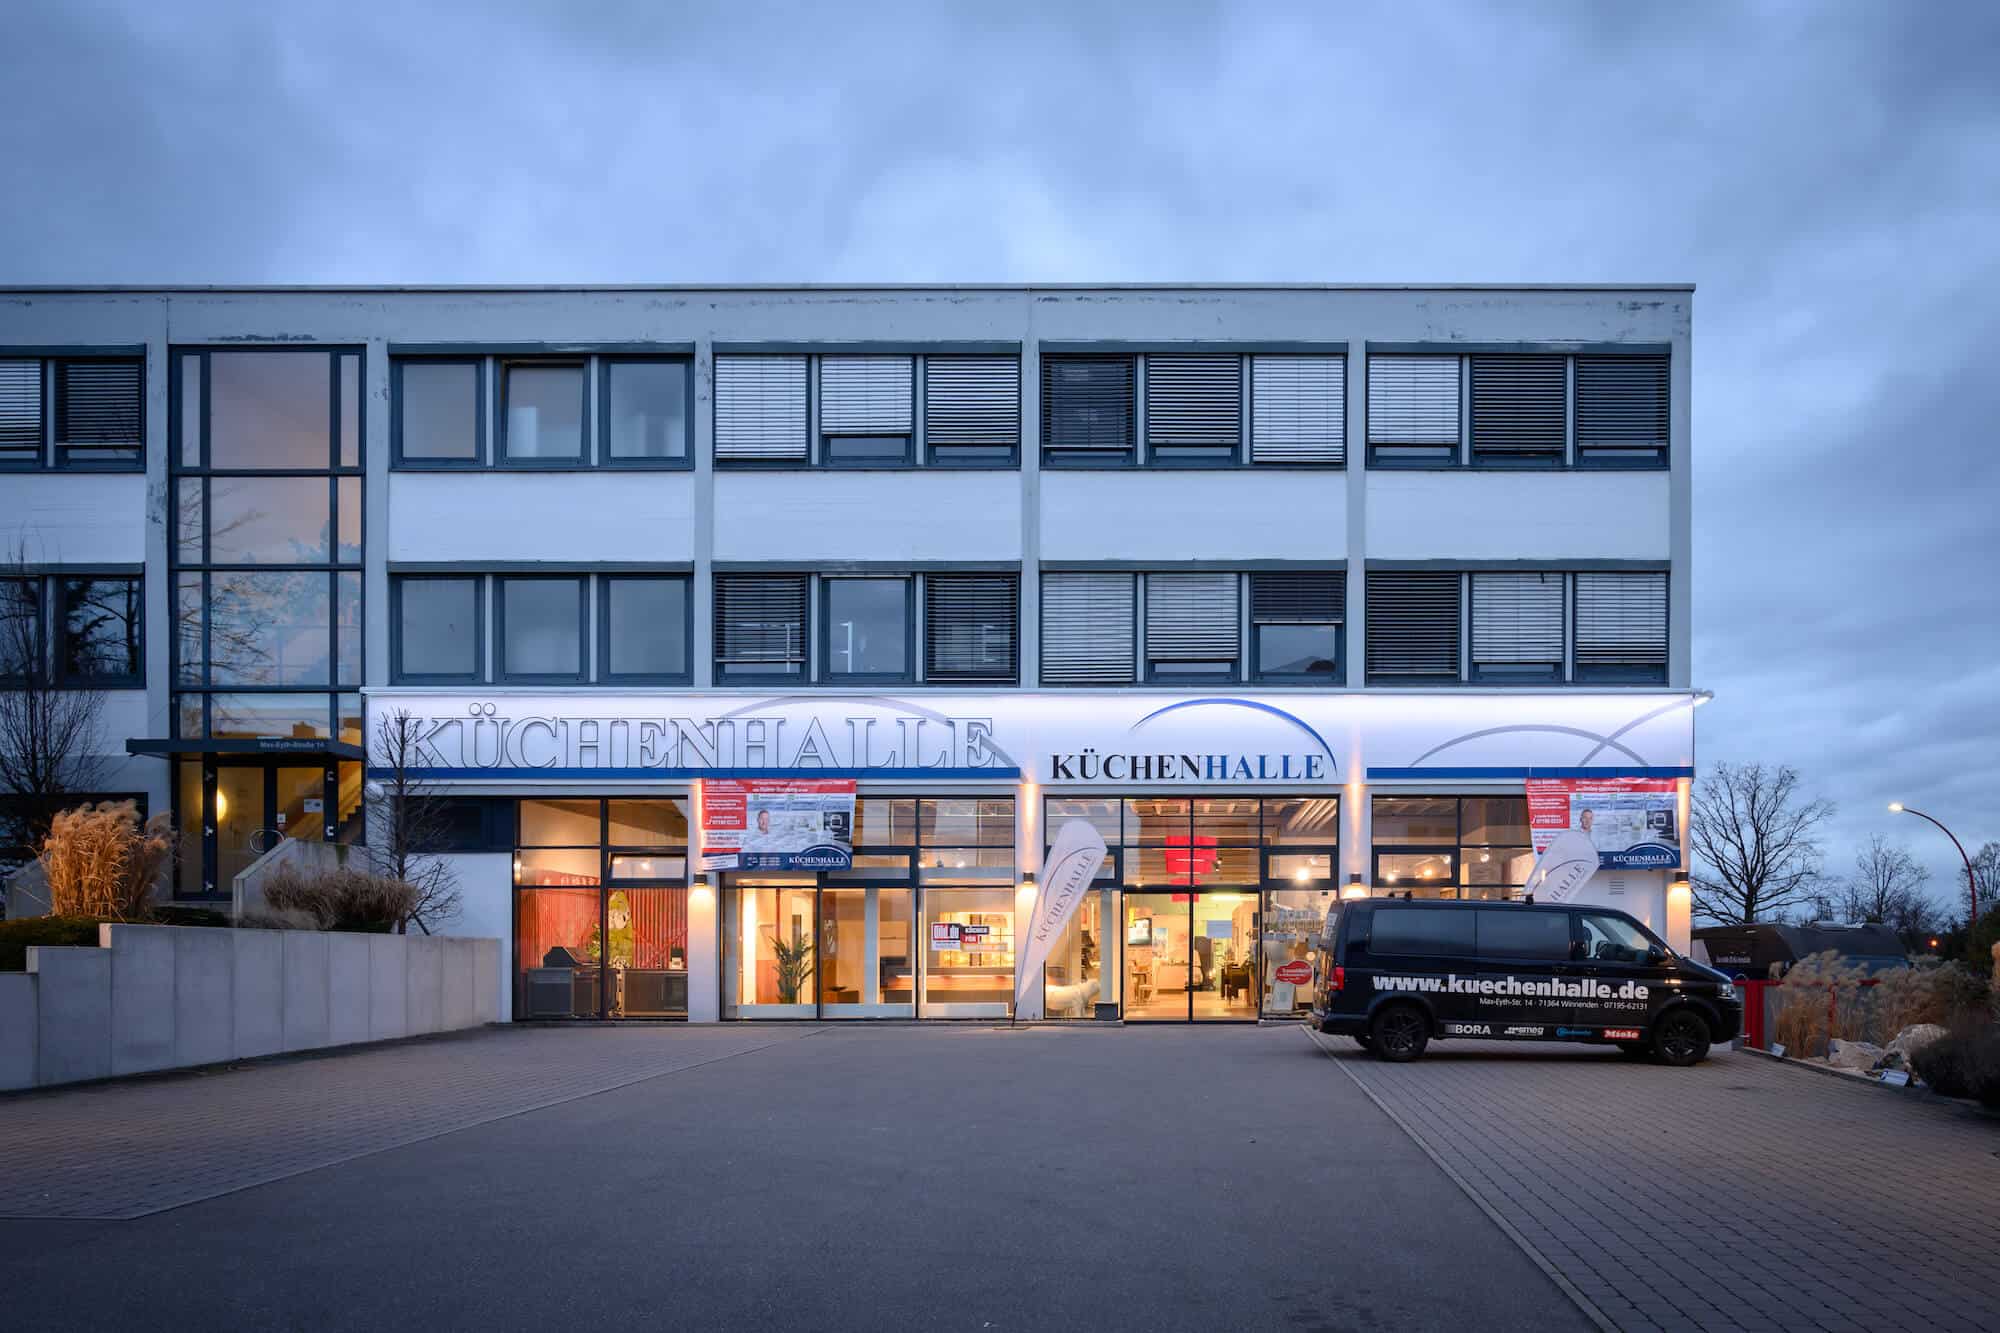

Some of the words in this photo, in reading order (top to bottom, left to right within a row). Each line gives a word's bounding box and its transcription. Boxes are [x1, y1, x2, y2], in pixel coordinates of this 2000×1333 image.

[394, 702, 998, 768] KÜCHENHALLE
[1050, 748, 1325, 780] KÜCHENHALLE
[788, 855, 846, 864] KÜCHENHALLE
[1613, 854, 1672, 863] KÜCHENHALLE
[1372, 974, 1649, 999] www.kuechenhalle.de
[1560, 1000, 1599, 1008] Winnenden
[1455, 1024, 1491, 1035] BORA
